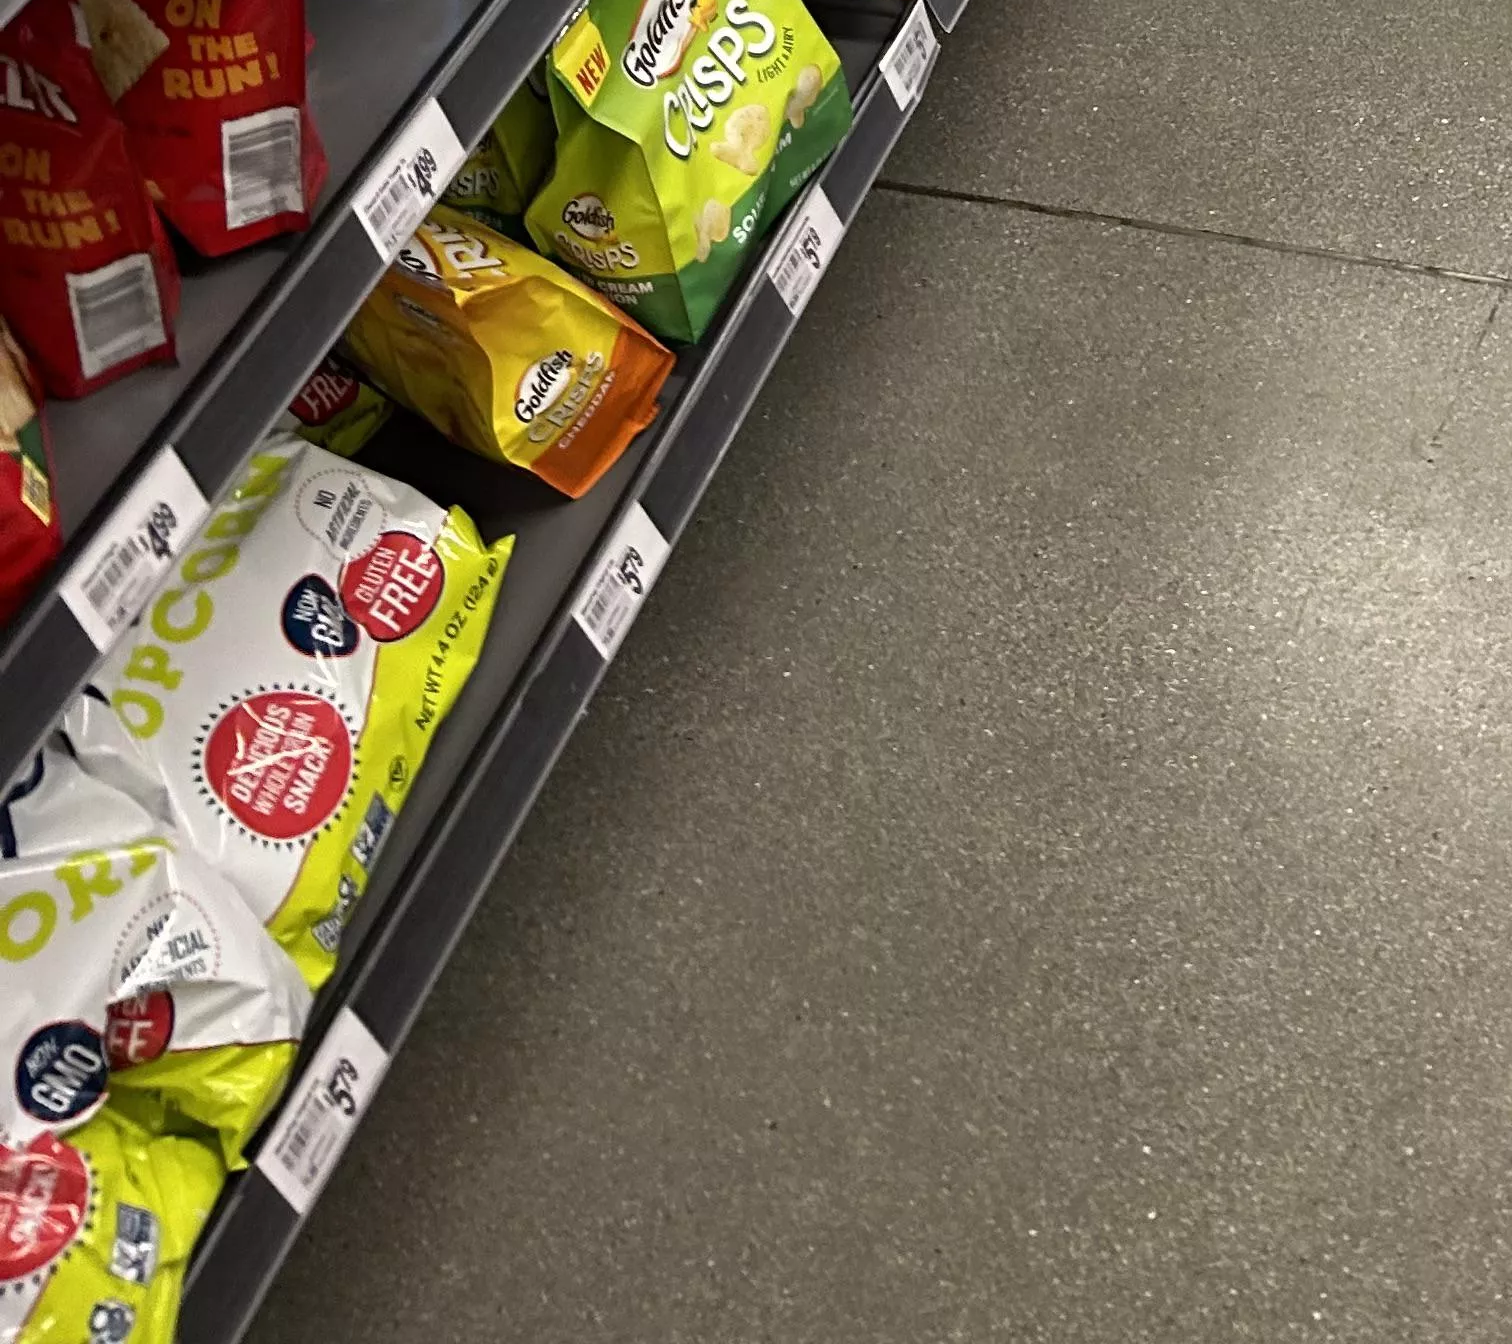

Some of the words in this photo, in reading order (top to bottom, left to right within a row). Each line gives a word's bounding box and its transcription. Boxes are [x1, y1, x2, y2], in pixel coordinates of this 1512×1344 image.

[187, 31, 260, 63] THE
[575, 46, 607, 97] NEW
[756, 56, 784, 84] LIGHT
[783, 25, 794, 54] AIRY
[162, 50, 283, 102] RUN!
[0, 146, 52, 189] ON
[22, 187, 94, 218] THE
[562, 199, 615, 231] Goldfish
[553, 231, 639, 272] CRISPS
[513, 348, 574, 425] Goldfish
[528, 350, 606, 445] CRISPS
[312, 488, 339, 509] NO
[111, 454, 292, 741] OPCORN
[354, 545, 398, 606] GLUTEN
[368, 546, 440, 634] FREE
[443, 613, 466, 644] OZ
[436, 639, 455, 670] 4.4
[423, 667, 446, 703] WT
[414, 696, 440, 733] NET
[230, 702, 293, 805] DELICIOUS
[250, 754, 292, 816] WHOLE
[31, 1043, 103, 1113] GMO
